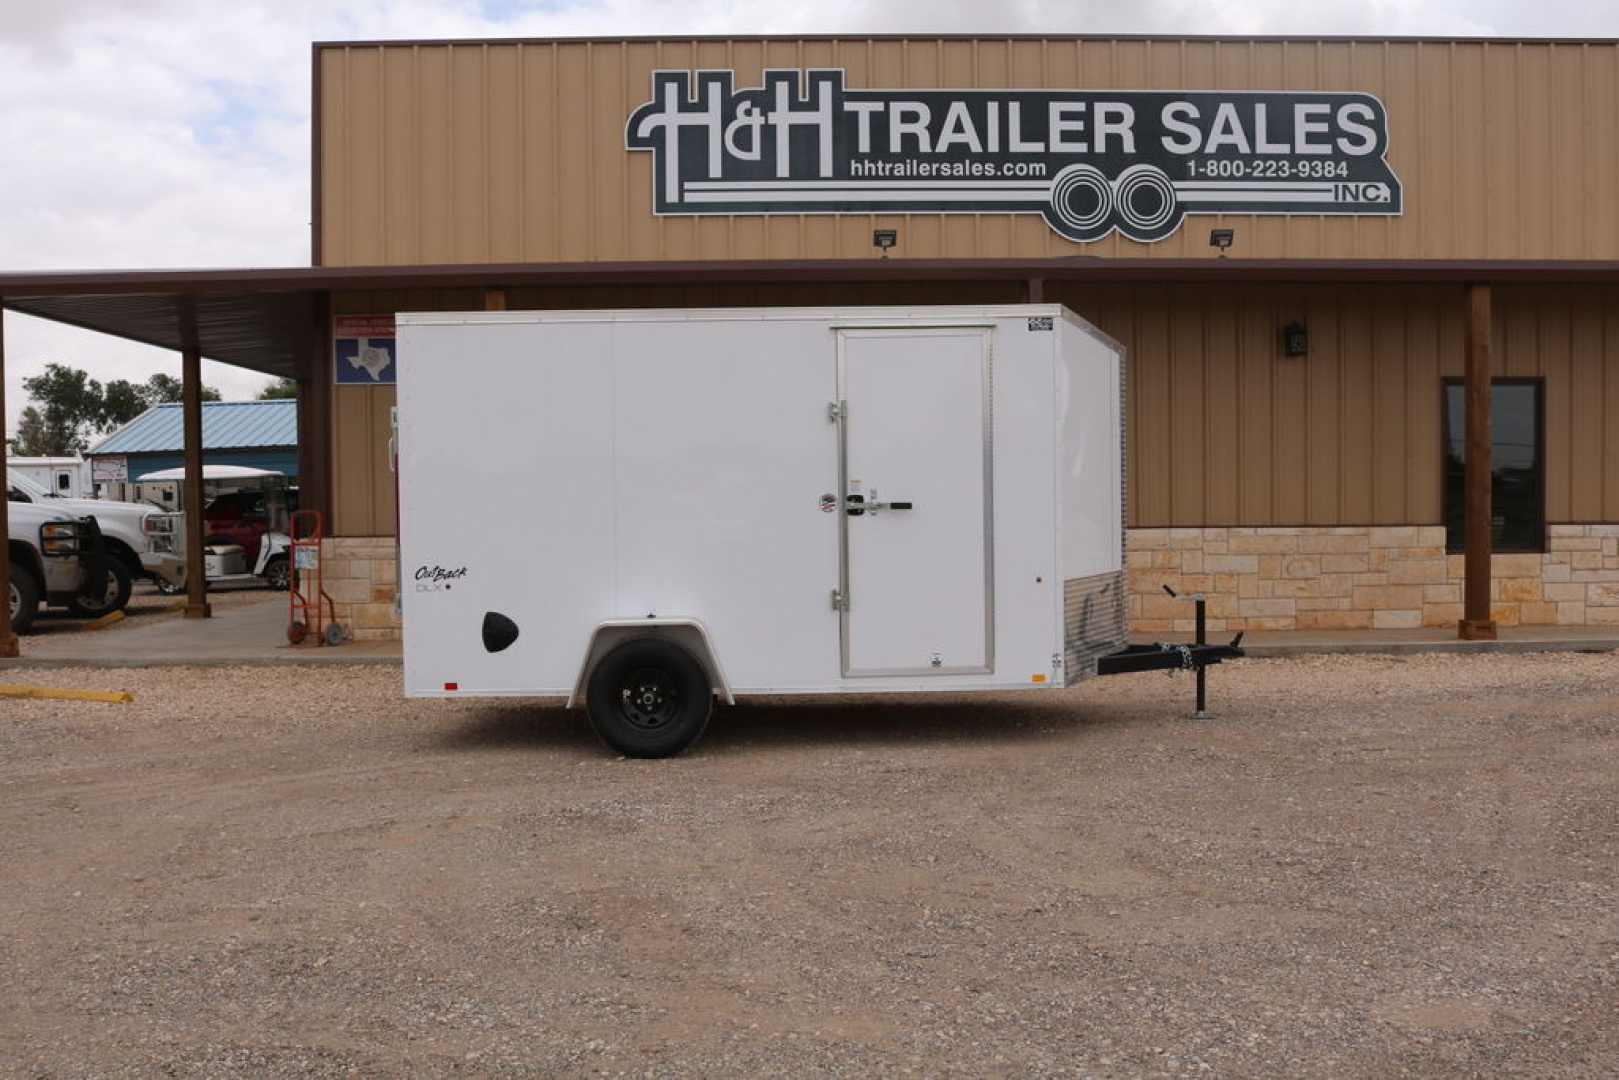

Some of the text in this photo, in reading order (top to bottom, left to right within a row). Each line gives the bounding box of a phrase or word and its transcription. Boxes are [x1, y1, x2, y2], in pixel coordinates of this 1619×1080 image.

[637, 80, 1378, 203] H&H TRAILER SALES
[850, 159, 1046, 178] hhtrailersales.com
[1186, 160, 1349, 178] 1-800-223-9384
[1332, 183, 1390, 203] INC.
